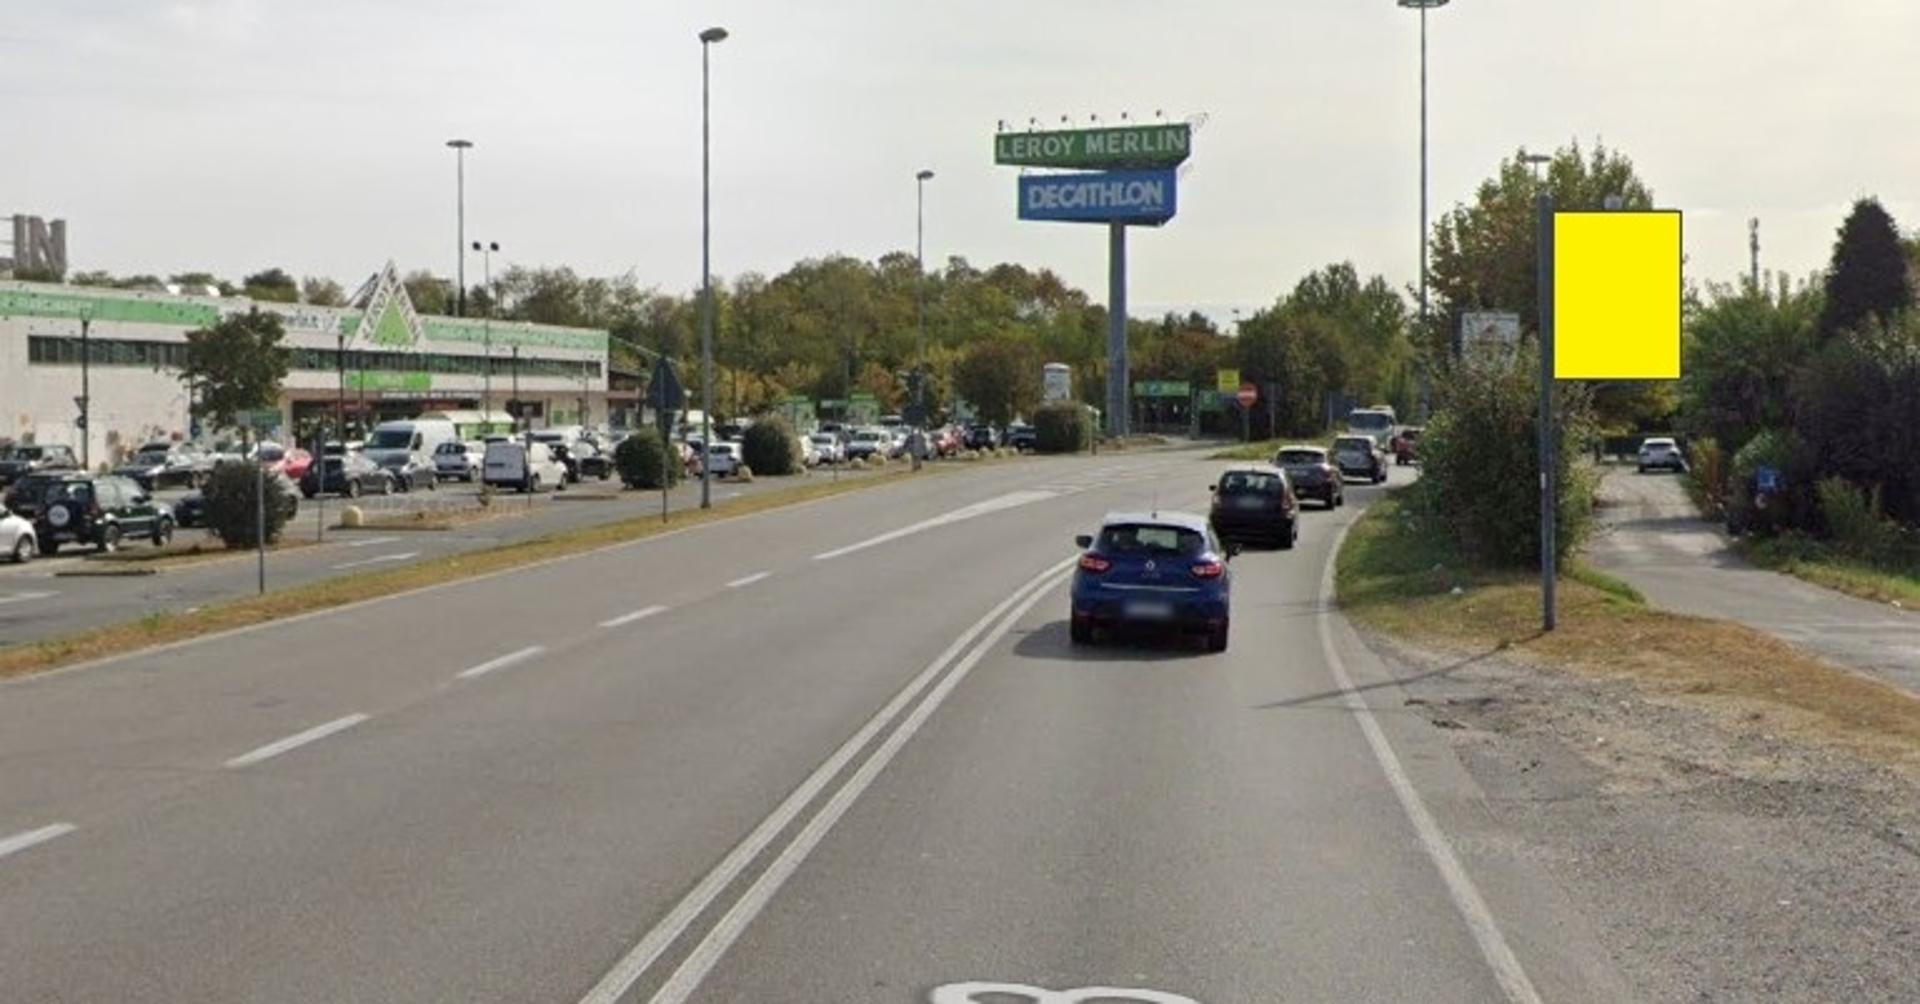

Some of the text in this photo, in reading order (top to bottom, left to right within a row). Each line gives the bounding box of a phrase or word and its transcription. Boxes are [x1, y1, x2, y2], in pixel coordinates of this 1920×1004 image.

[1000, 129, 1187, 159] LEROY MERLIN
[1028, 180, 1163, 209] DECATHLON
[0, 214, 66, 282] IN
